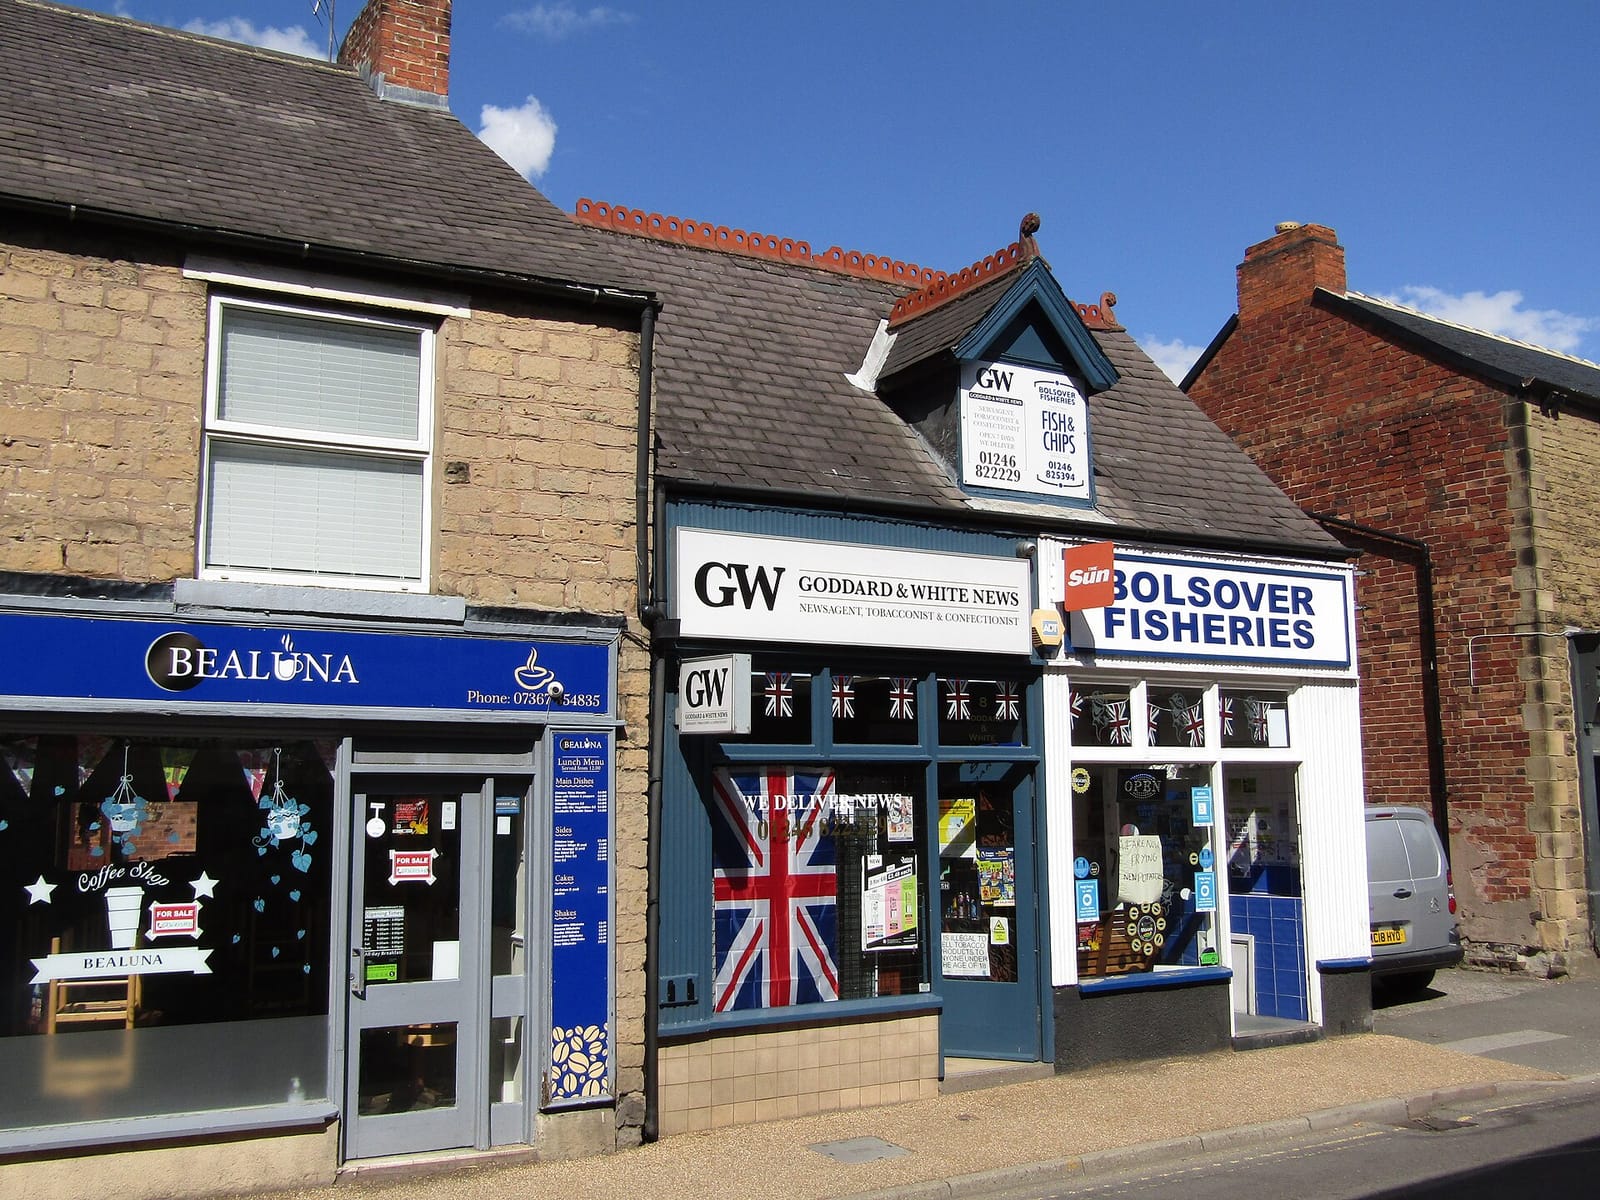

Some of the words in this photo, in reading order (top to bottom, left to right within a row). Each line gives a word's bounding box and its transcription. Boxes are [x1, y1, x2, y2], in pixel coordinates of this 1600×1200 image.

[976, 367, 1014, 392] GW
[1039, 386, 1076, 399] BOLSOVER
[1040, 394, 1076, 405] FISHERIES
[1043, 431, 1076, 454] CHIPS
[979, 451, 1016, 468] 01246
[1048, 461, 1072, 471] 01246
[975, 465, 1021, 482] 822229
[1045, 470, 1075, 481] 825394
[1067, 568, 1110, 587] Sun
[694, 561, 786, 611] GW
[798, 575, 893, 597] GODDARD
[896, 582, 909, 599] &
[910, 584, 968, 603] WHITE
[973, 589, 1019, 606] NEWS
[1113, 570, 1315, 616] BOLSOVER
[799, 603, 864, 617] NEWSAGENT,
[865, 607, 935, 621] TOBACCONIST
[936, 612, 943, 621] &
[945, 613, 1019, 626] CONFECTIONIST
[1043, 623, 1058, 632] ADT
[1104, 607, 1315, 649] FISHERIES
[167, 645, 360, 684] BEALUNA
[686, 668, 728, 708] GW
[467, 690, 511, 704] Phone:
[561, 693, 601, 707] 54835
[564, 739, 602, 749] BEALUNA
[558, 758, 581, 766] Lunch
[583, 758, 605, 766] Menu
[555, 777, 572, 785] Main
[573, 777, 594, 785] Dishes
[1124, 780, 1161, 793] OPEN
[743, 794, 769, 811] WE
[773, 794, 852, 811] DELIVER
[855, 794, 903, 810] NEWS
[555, 826, 573, 834] Sides
[77, 863, 125, 892] Coffee
[129, 861, 170, 887] Shop
[554, 874, 575, 882] Cakes
[156, 910, 173, 918] FOR
[173, 909, 194, 917] SALE
[554, 909, 577, 917] Shakes
[83, 954, 163, 970] BEALUNA
[964, 955, 988, 963] UNDER
